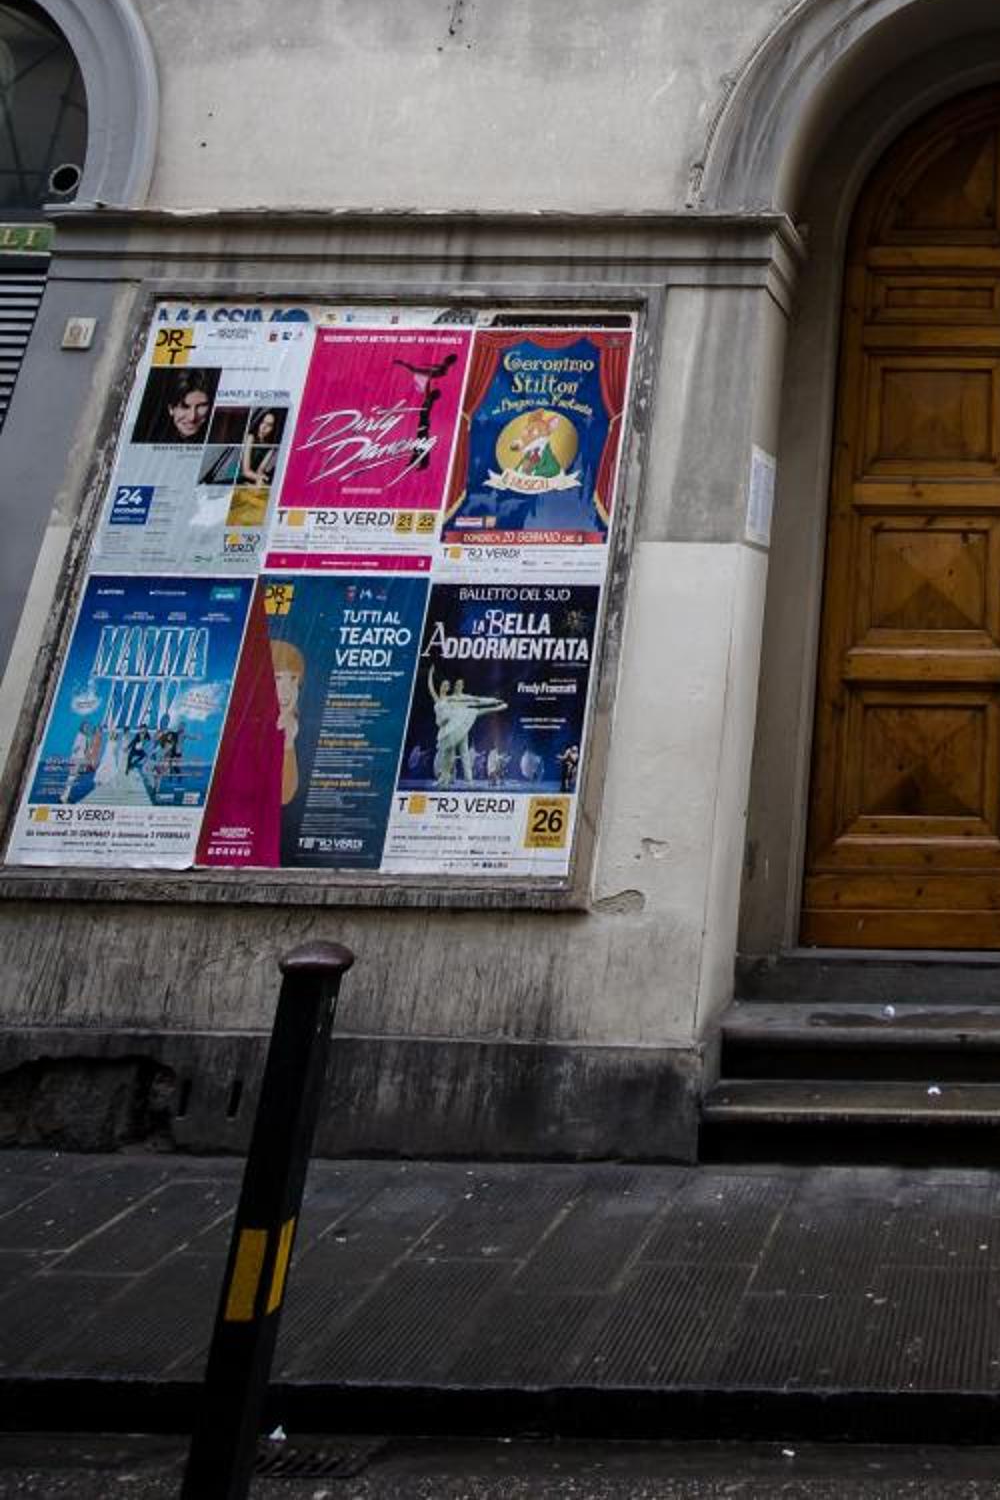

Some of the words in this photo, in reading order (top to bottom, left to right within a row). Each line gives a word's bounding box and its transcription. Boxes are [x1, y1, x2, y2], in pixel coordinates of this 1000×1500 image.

[503, 350, 595, 373] Geronimo
[511, 372, 579, 395] Stilton
[296, 399, 429, 451] Dirty
[307, 435, 438, 487] Dancing
[115, 488, 144, 505] 24
[343, 511, 395, 526] VERDI
[486, 548, 522, 560] VERDI
[459, 587, 519, 601] BALLETTO
[519, 588, 542, 601] DEL
[543, 588, 571, 601] SUD
[343, 609, 381, 624] TUTTI
[382, 610, 401, 625] AL
[472, 619, 485, 635] LA
[485, 608, 551, 637] BELLA
[339, 626, 412, 647] TEATRO
[421, 621, 589, 661] ADDORMENTATA
[91, 625, 209, 680] MAMMA
[335, 648, 392, 668] VERDI
[76, 809, 115, 822] VERDI
[464, 798, 515, 814] VERDI
[531, 809, 563, 833] 26
